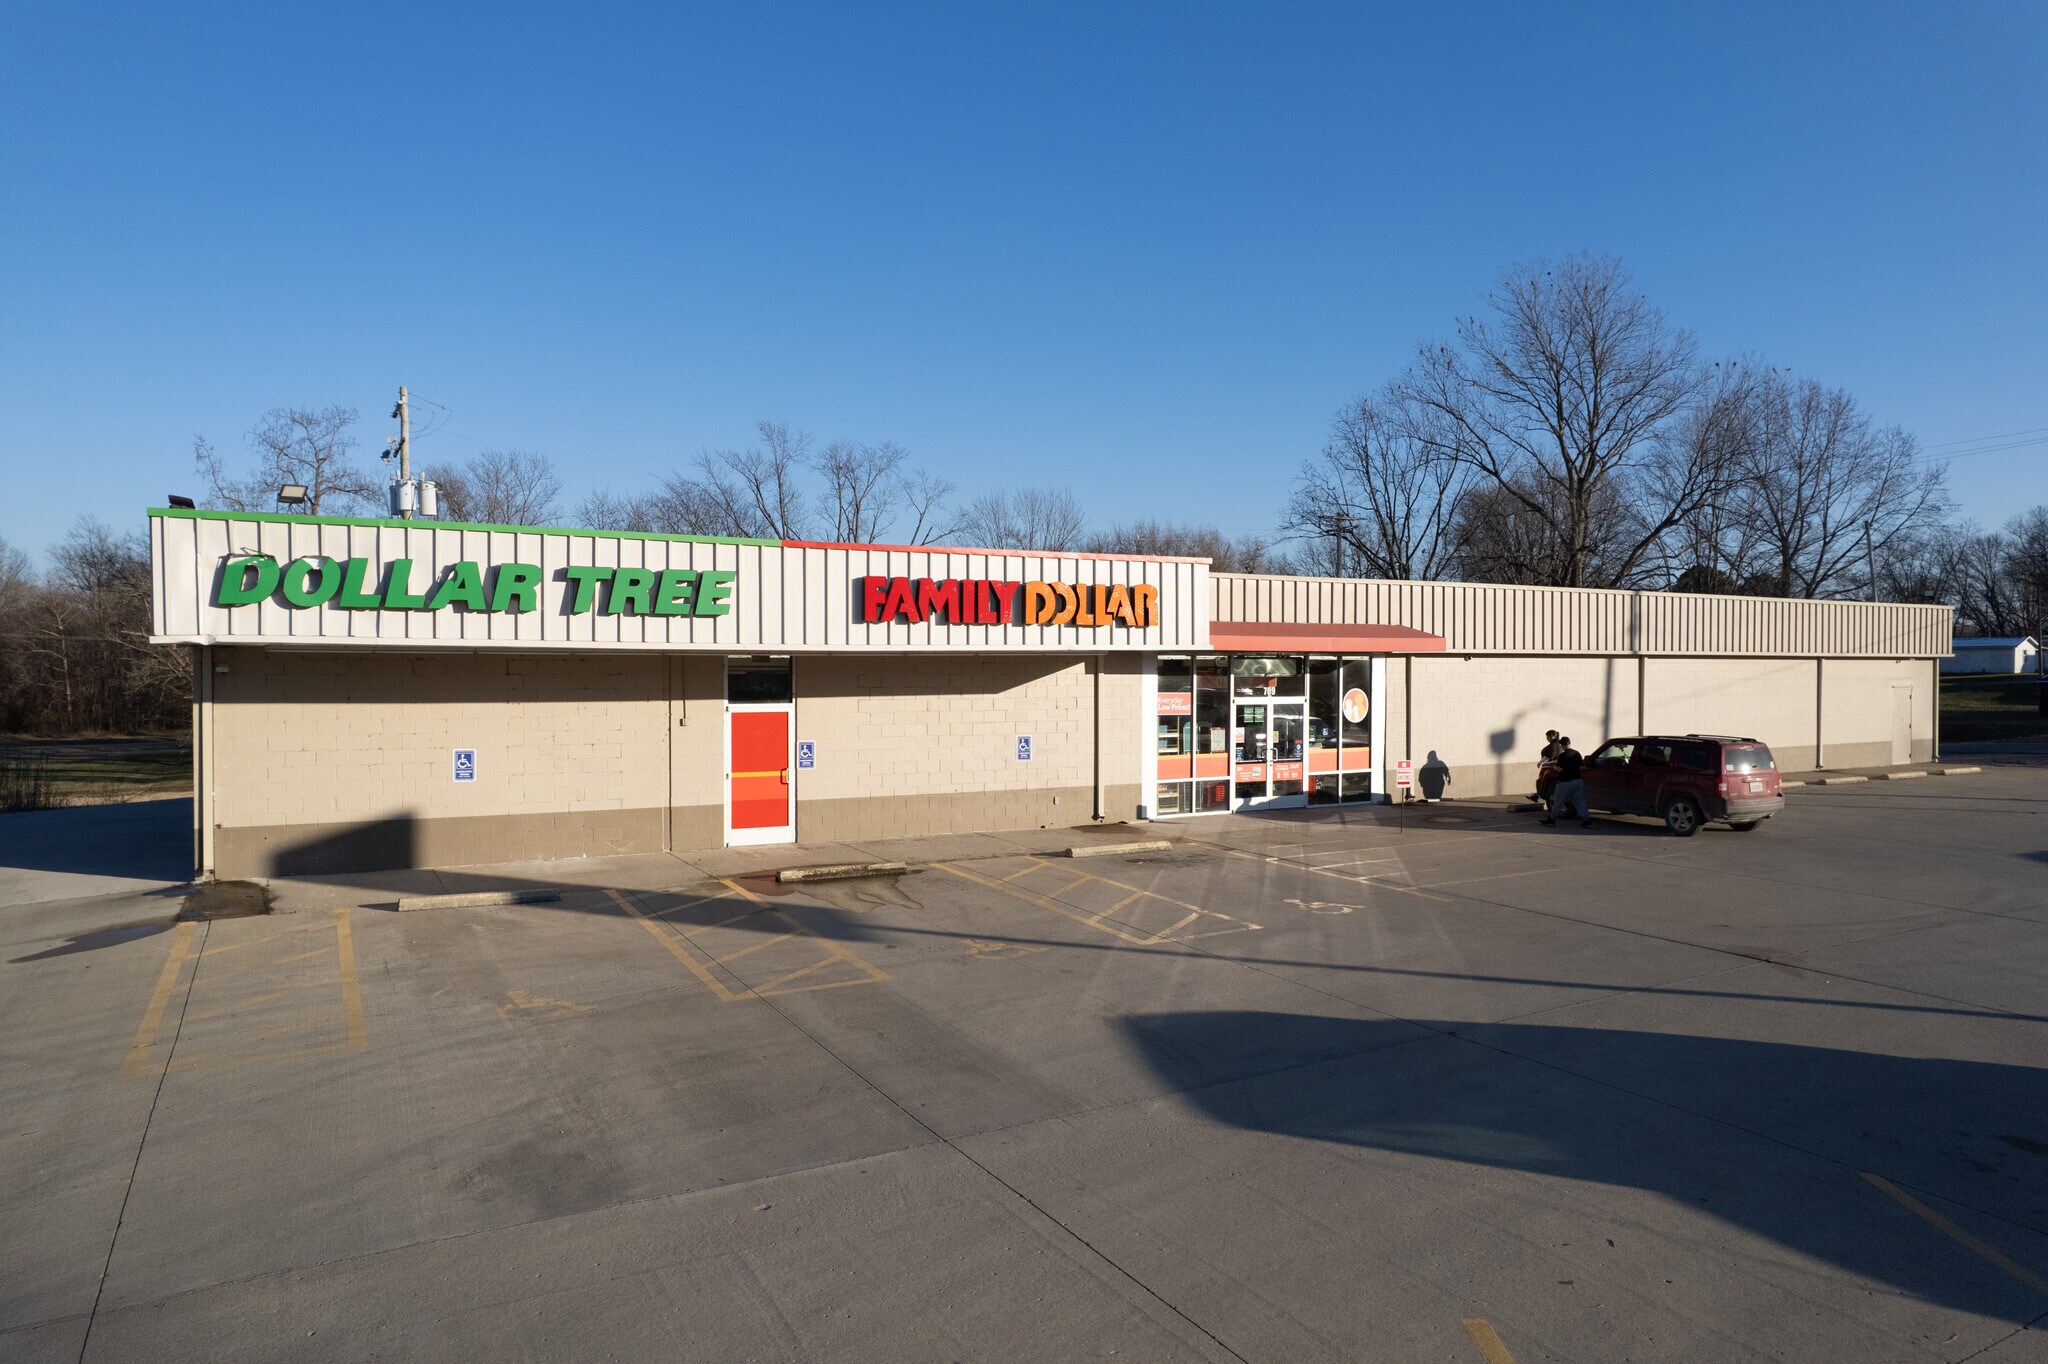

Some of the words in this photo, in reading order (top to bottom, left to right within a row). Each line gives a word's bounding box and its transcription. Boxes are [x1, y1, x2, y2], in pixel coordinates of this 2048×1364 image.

[217, 553, 543, 612] DOLLAR
[566, 565, 736, 616] TREE
[864, 576, 1020, 625] FAMILY
[1025, 580, 1158, 627] DOLLAR
[1158, 696, 1184, 705] Everyday
[1263, 687, 1276, 696] 709
